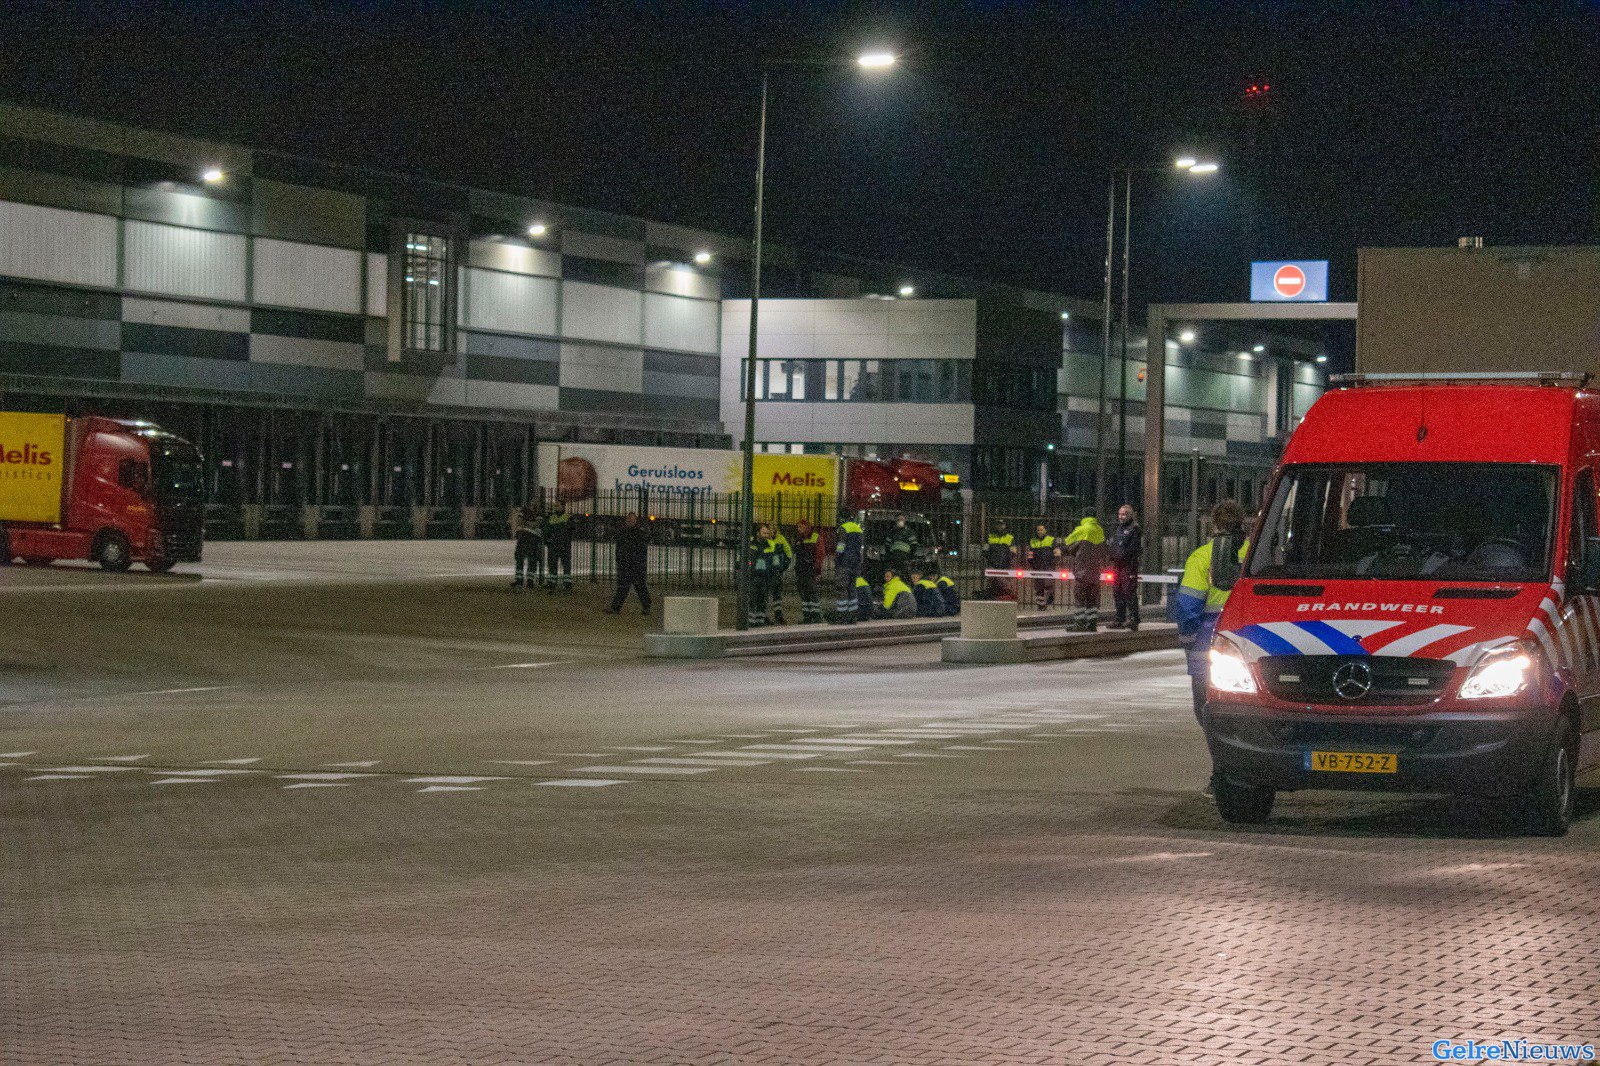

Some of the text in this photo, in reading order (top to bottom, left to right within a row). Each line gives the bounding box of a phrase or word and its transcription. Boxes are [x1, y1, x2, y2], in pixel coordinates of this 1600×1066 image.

[628, 464, 703, 480] Geruisloos
[772, 471, 826, 488] Melis
[1296, 602, 1445, 615] BRANDWEER
[1318, 753, 1390, 770] VB-752-Z
